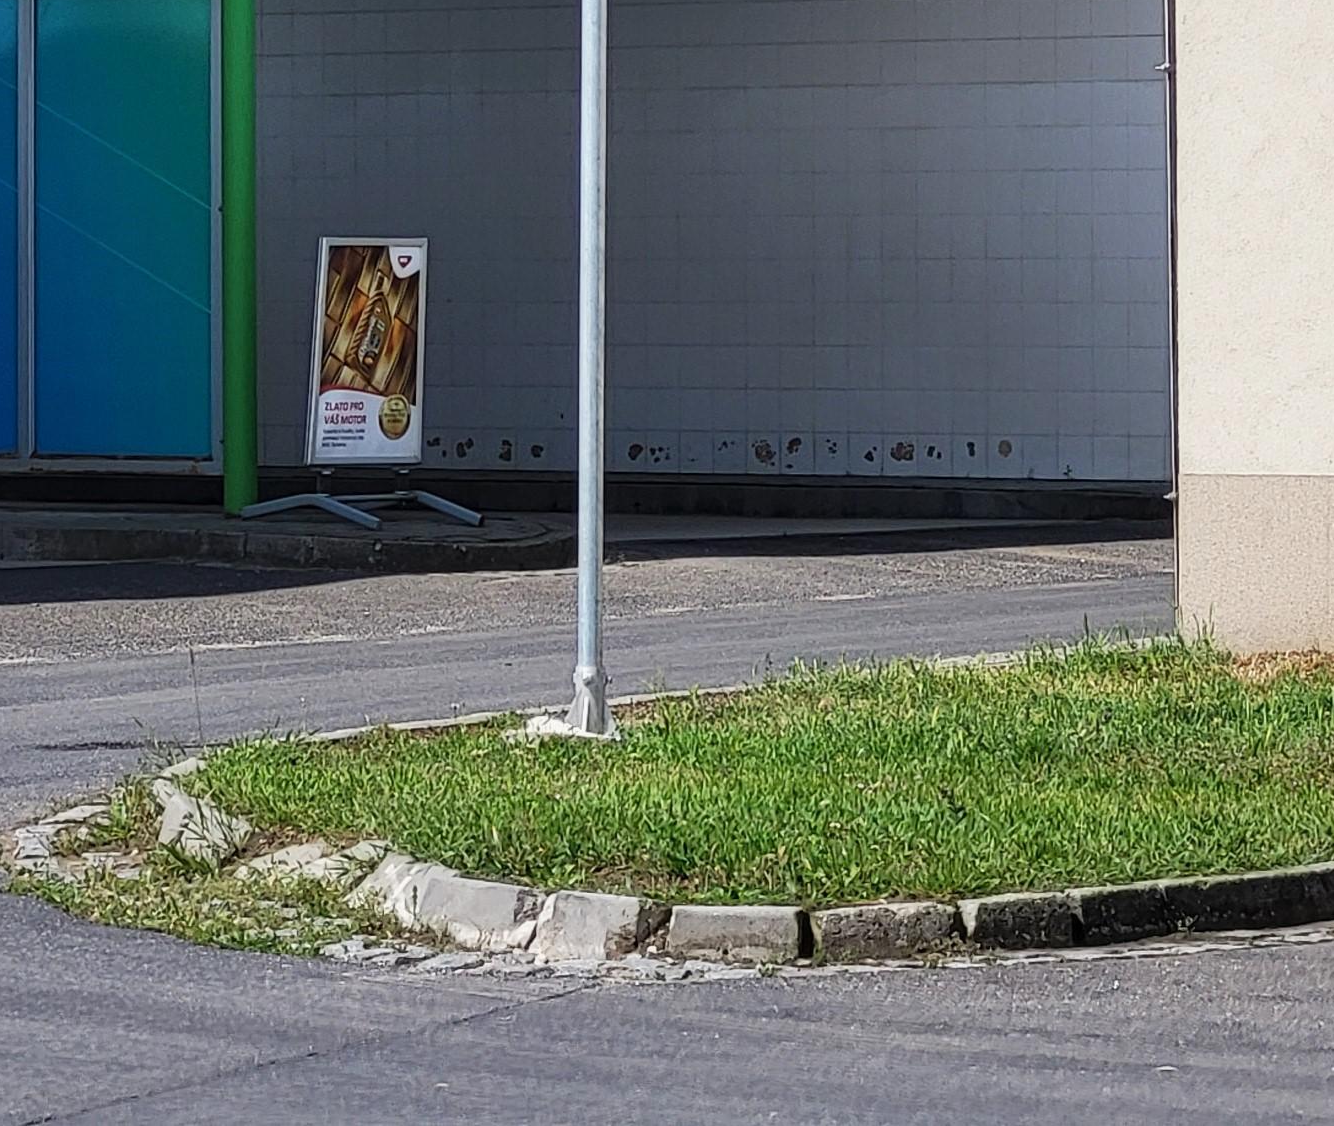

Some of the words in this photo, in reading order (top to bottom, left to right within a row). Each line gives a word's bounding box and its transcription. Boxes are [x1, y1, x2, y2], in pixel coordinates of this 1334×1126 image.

[324, 401, 348, 411] ZLATO
[350, 401, 364, 411] PRO
[324, 413, 339, 425] VÁŠ
[341, 415, 367, 425] MOTOR
